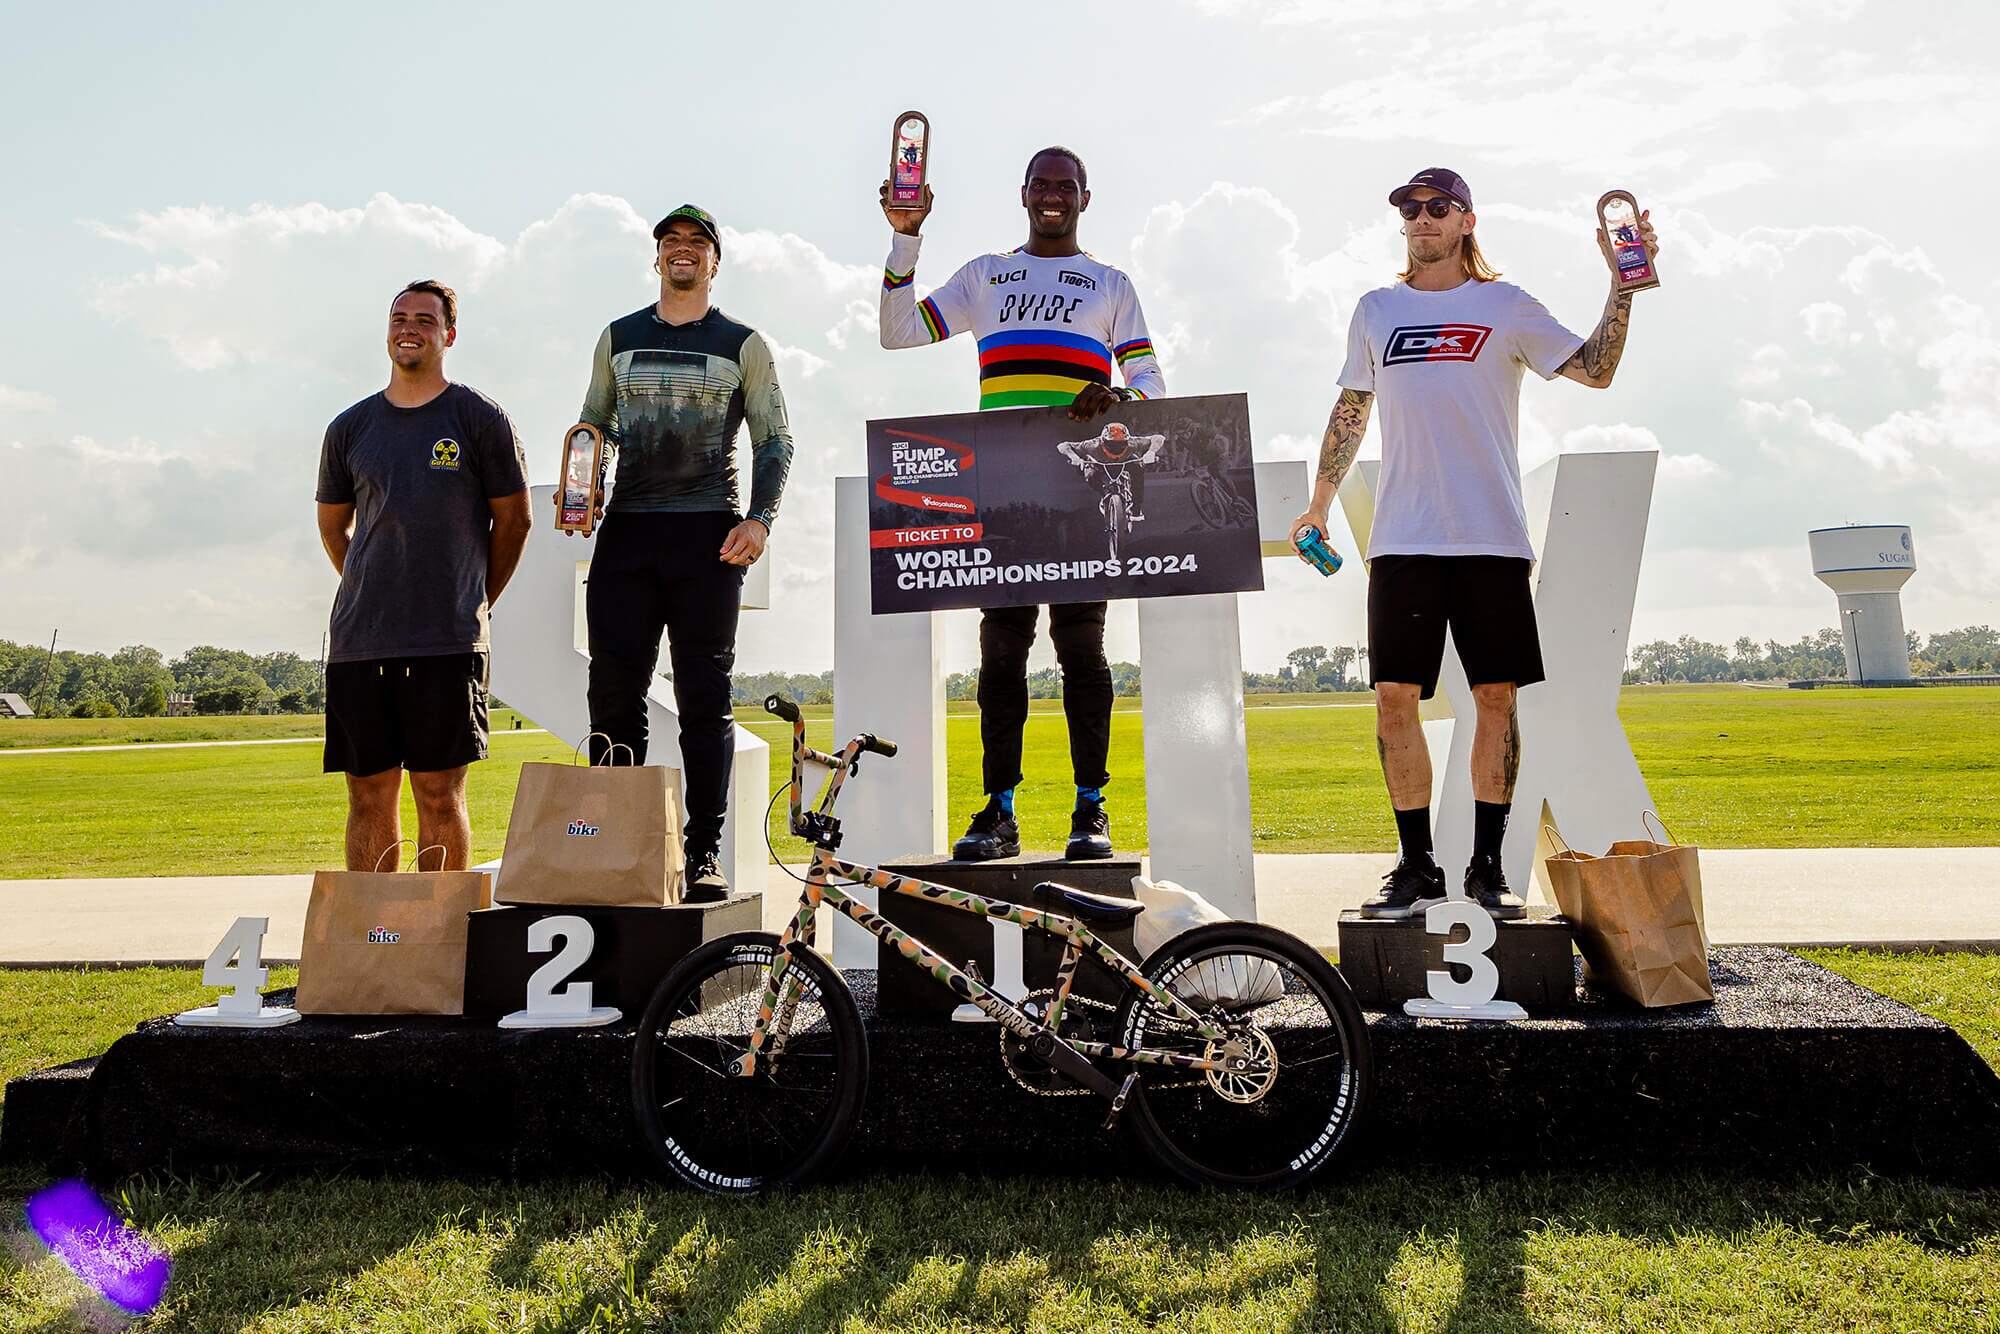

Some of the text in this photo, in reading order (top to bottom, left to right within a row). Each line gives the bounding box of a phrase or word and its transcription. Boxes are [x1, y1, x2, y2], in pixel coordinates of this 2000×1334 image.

[997, 269, 1027, 285] UCI
[1063, 273, 1091, 289] 100%
[1401, 335, 1467, 350] DK
[892, 447, 946, 463] PUMP
[893, 458, 957, 475] TRACK
[913, 471, 958, 480] CHAMPIONSHIPS
[565, 512, 571, 521] 2
[895, 526, 975, 543] TICKET TO
[895, 547, 993, 571] WORLD
[897, 553, 1198, 591] CHAMPIONSHIPS 2024
[567, 820, 598, 836] bikr
[367, 926, 400, 944] bikr
[1425, 901, 1499, 1005] 3
[202, 917, 269, 1015] 4
[527, 916, 594, 1014] 2
[1290, 1084, 1349, 1170] alienation
[665, 1137, 742, 1188] alienation
